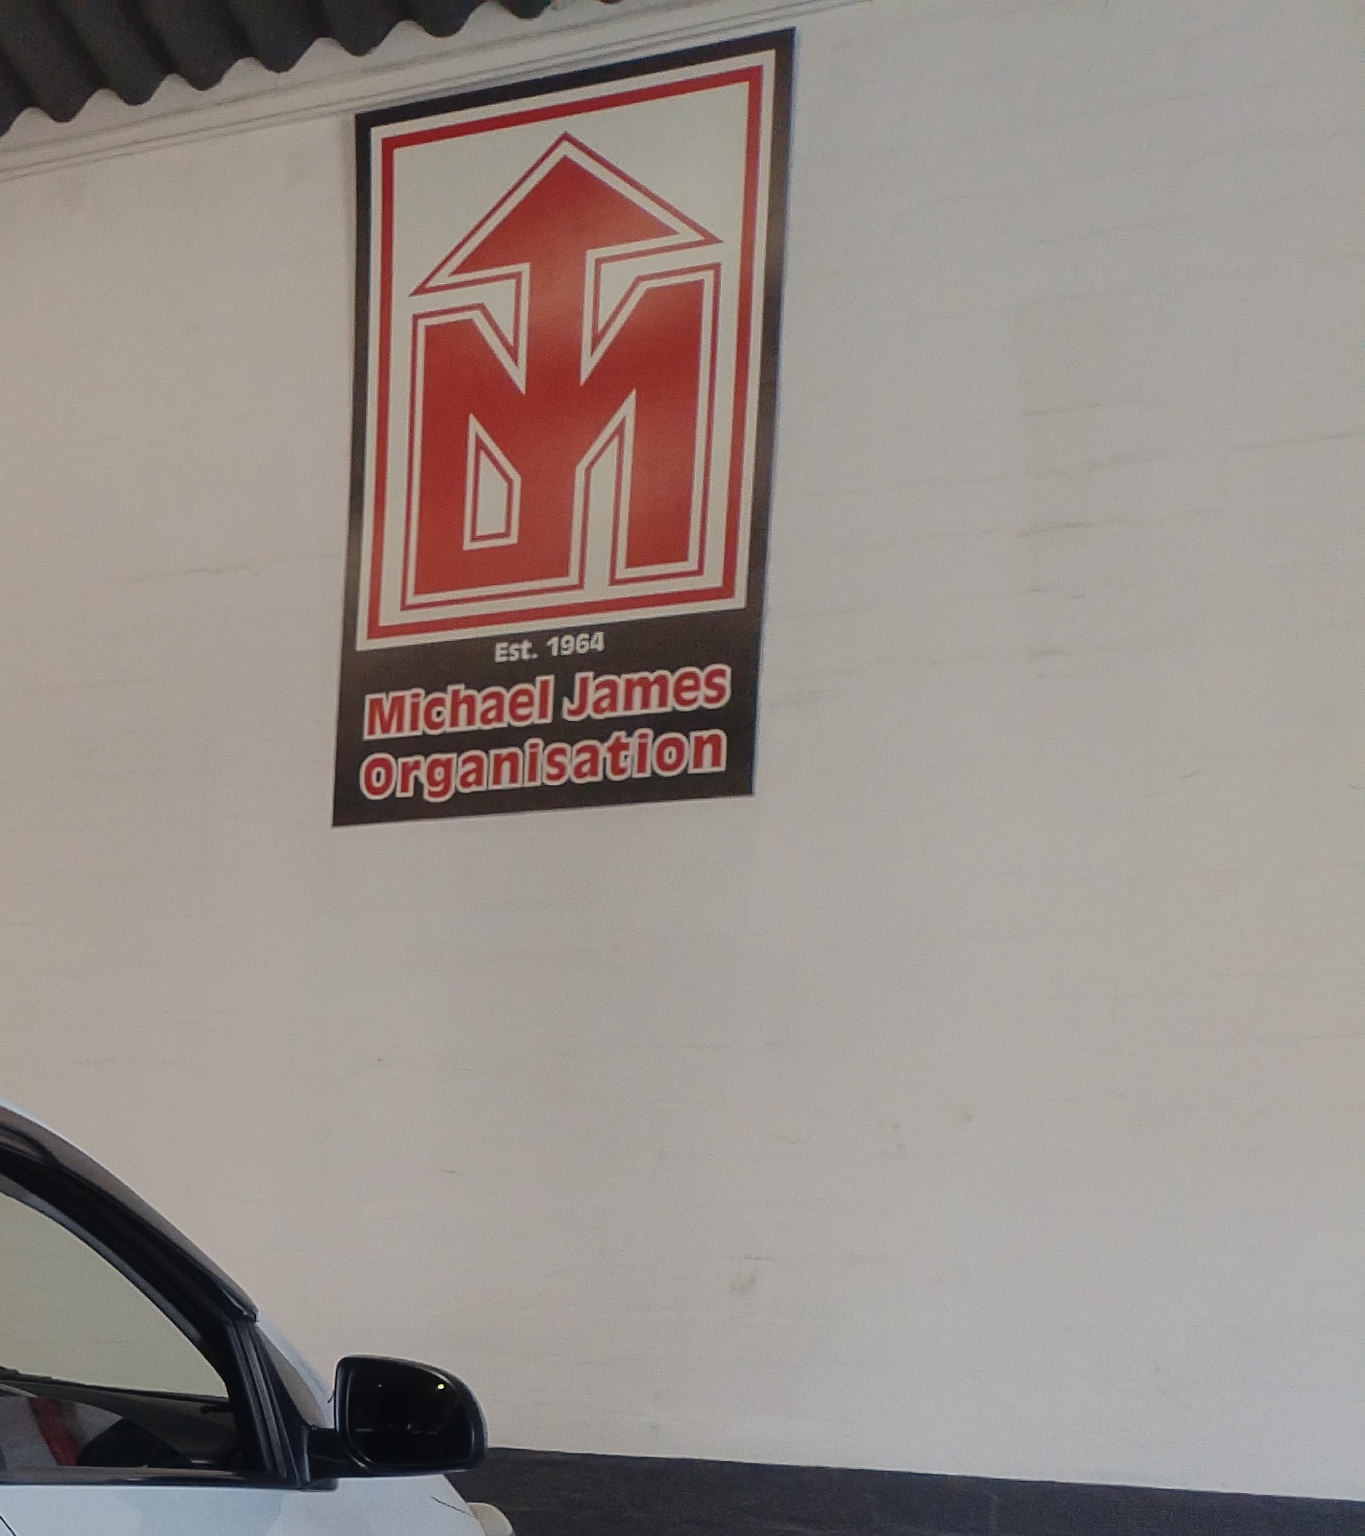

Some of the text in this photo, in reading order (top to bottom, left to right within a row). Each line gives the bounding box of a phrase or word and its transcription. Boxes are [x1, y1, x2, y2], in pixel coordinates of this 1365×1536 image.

[494, 631, 605, 663] Est. 1964
[363, 663, 732, 741] Michael James
[360, 728, 728, 802] Organisation
